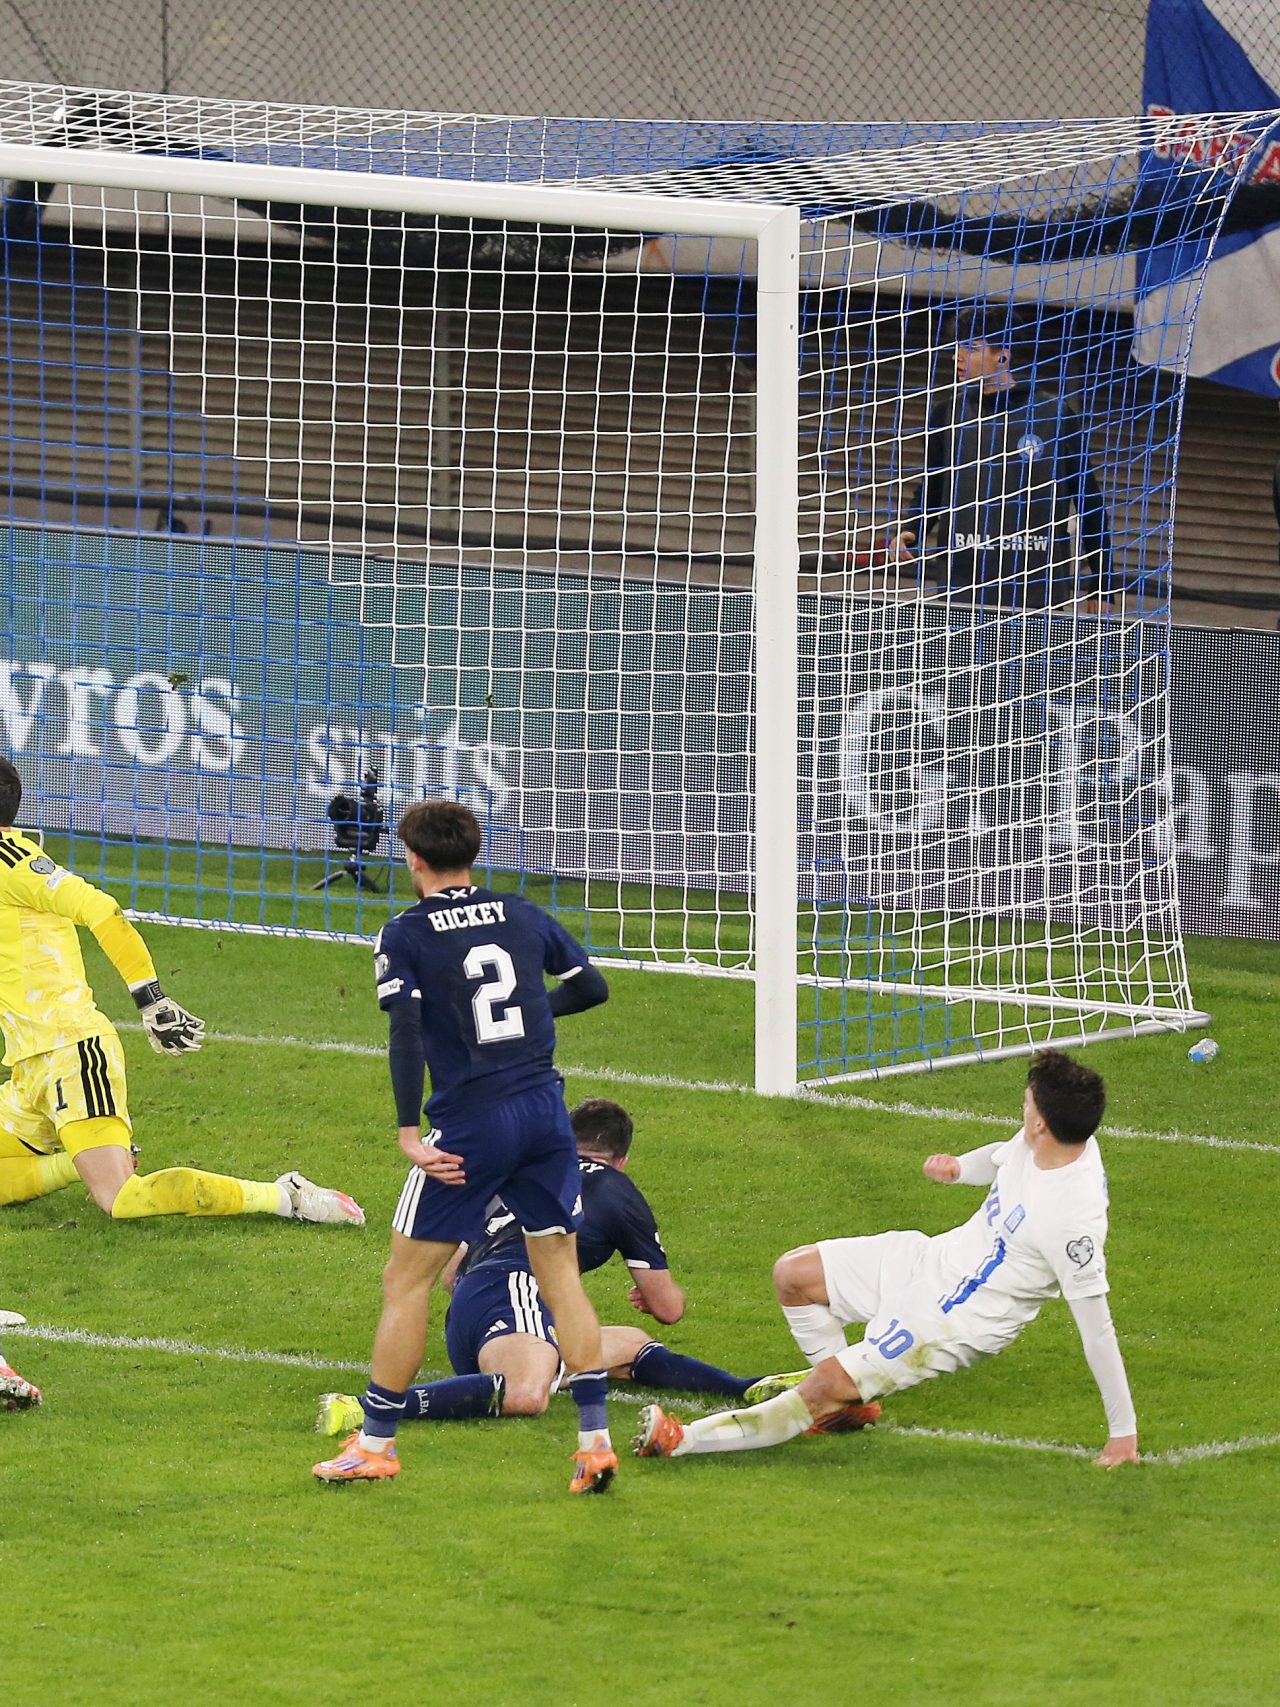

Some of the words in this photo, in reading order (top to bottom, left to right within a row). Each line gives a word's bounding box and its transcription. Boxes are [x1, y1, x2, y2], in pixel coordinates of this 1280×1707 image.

[955, 533, 995, 550] BALL
[1002, 535, 1049, 551] CREW
[428, 901, 507, 932] HICKEY
[463, 943, 525, 1044] 2
[55, 1077, 68, 1112] 1
[868, 1318, 914, 1360] 10
[415, 1389, 429, 1415] ALBA
